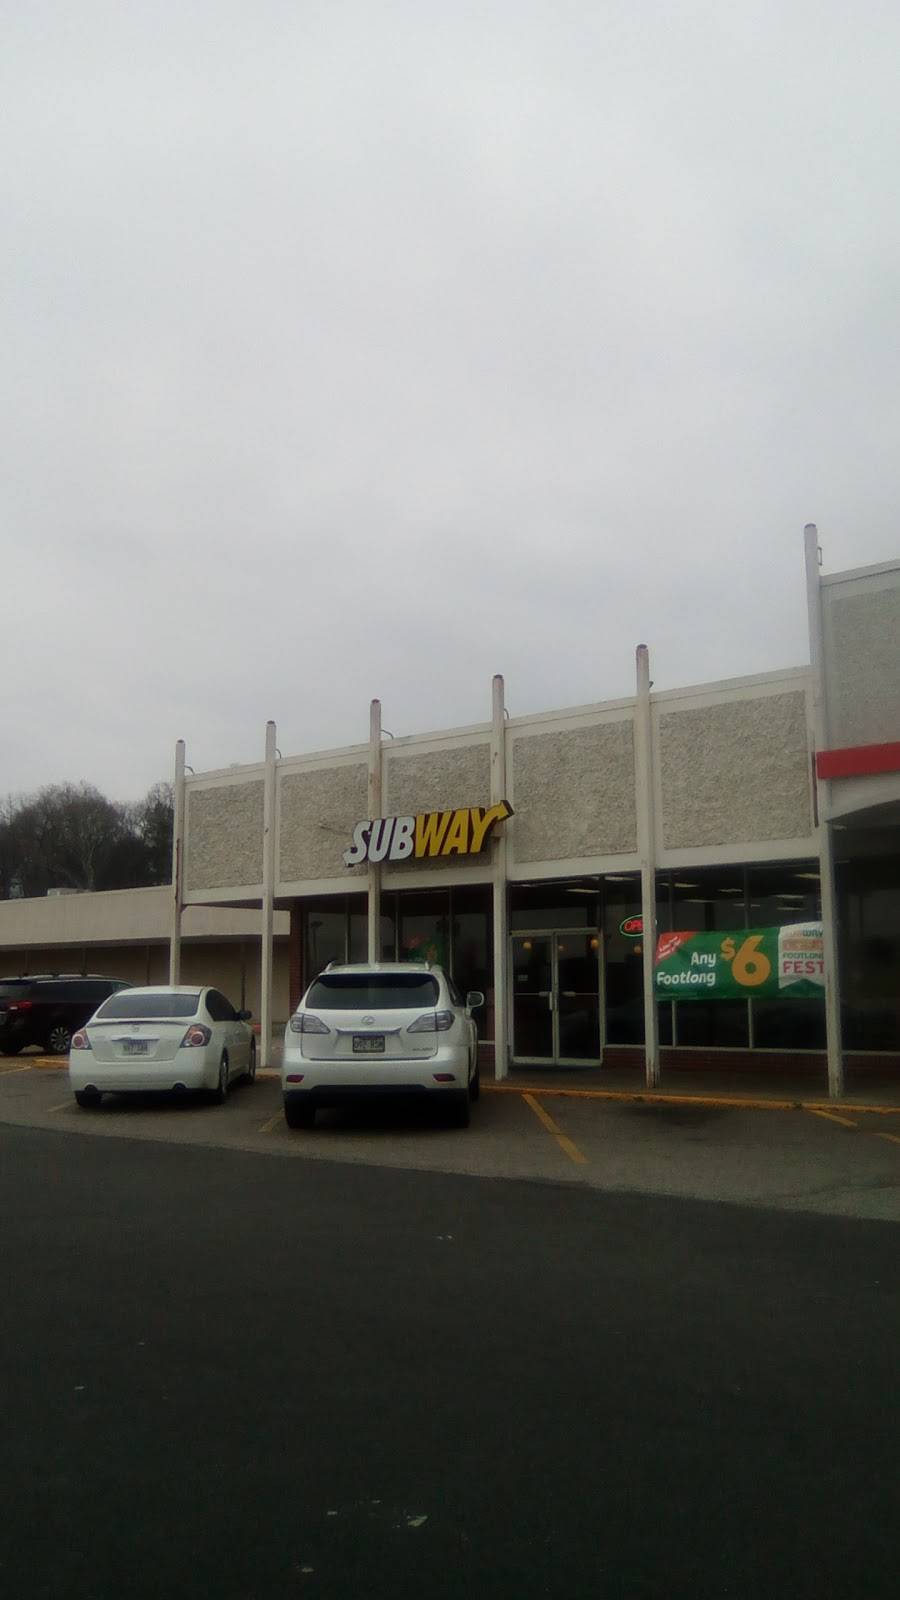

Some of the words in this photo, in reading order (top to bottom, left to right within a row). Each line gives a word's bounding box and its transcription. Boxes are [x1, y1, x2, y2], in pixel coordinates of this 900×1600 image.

[343, 799, 514, 866] SUBWAY
[691, 952, 717, 968] Any
[721, 935, 771, 987] $6
[783, 952, 824, 960] FOOTLON
[783, 960, 825, 974] FEST
[656, 970, 717, 986] Footlong
